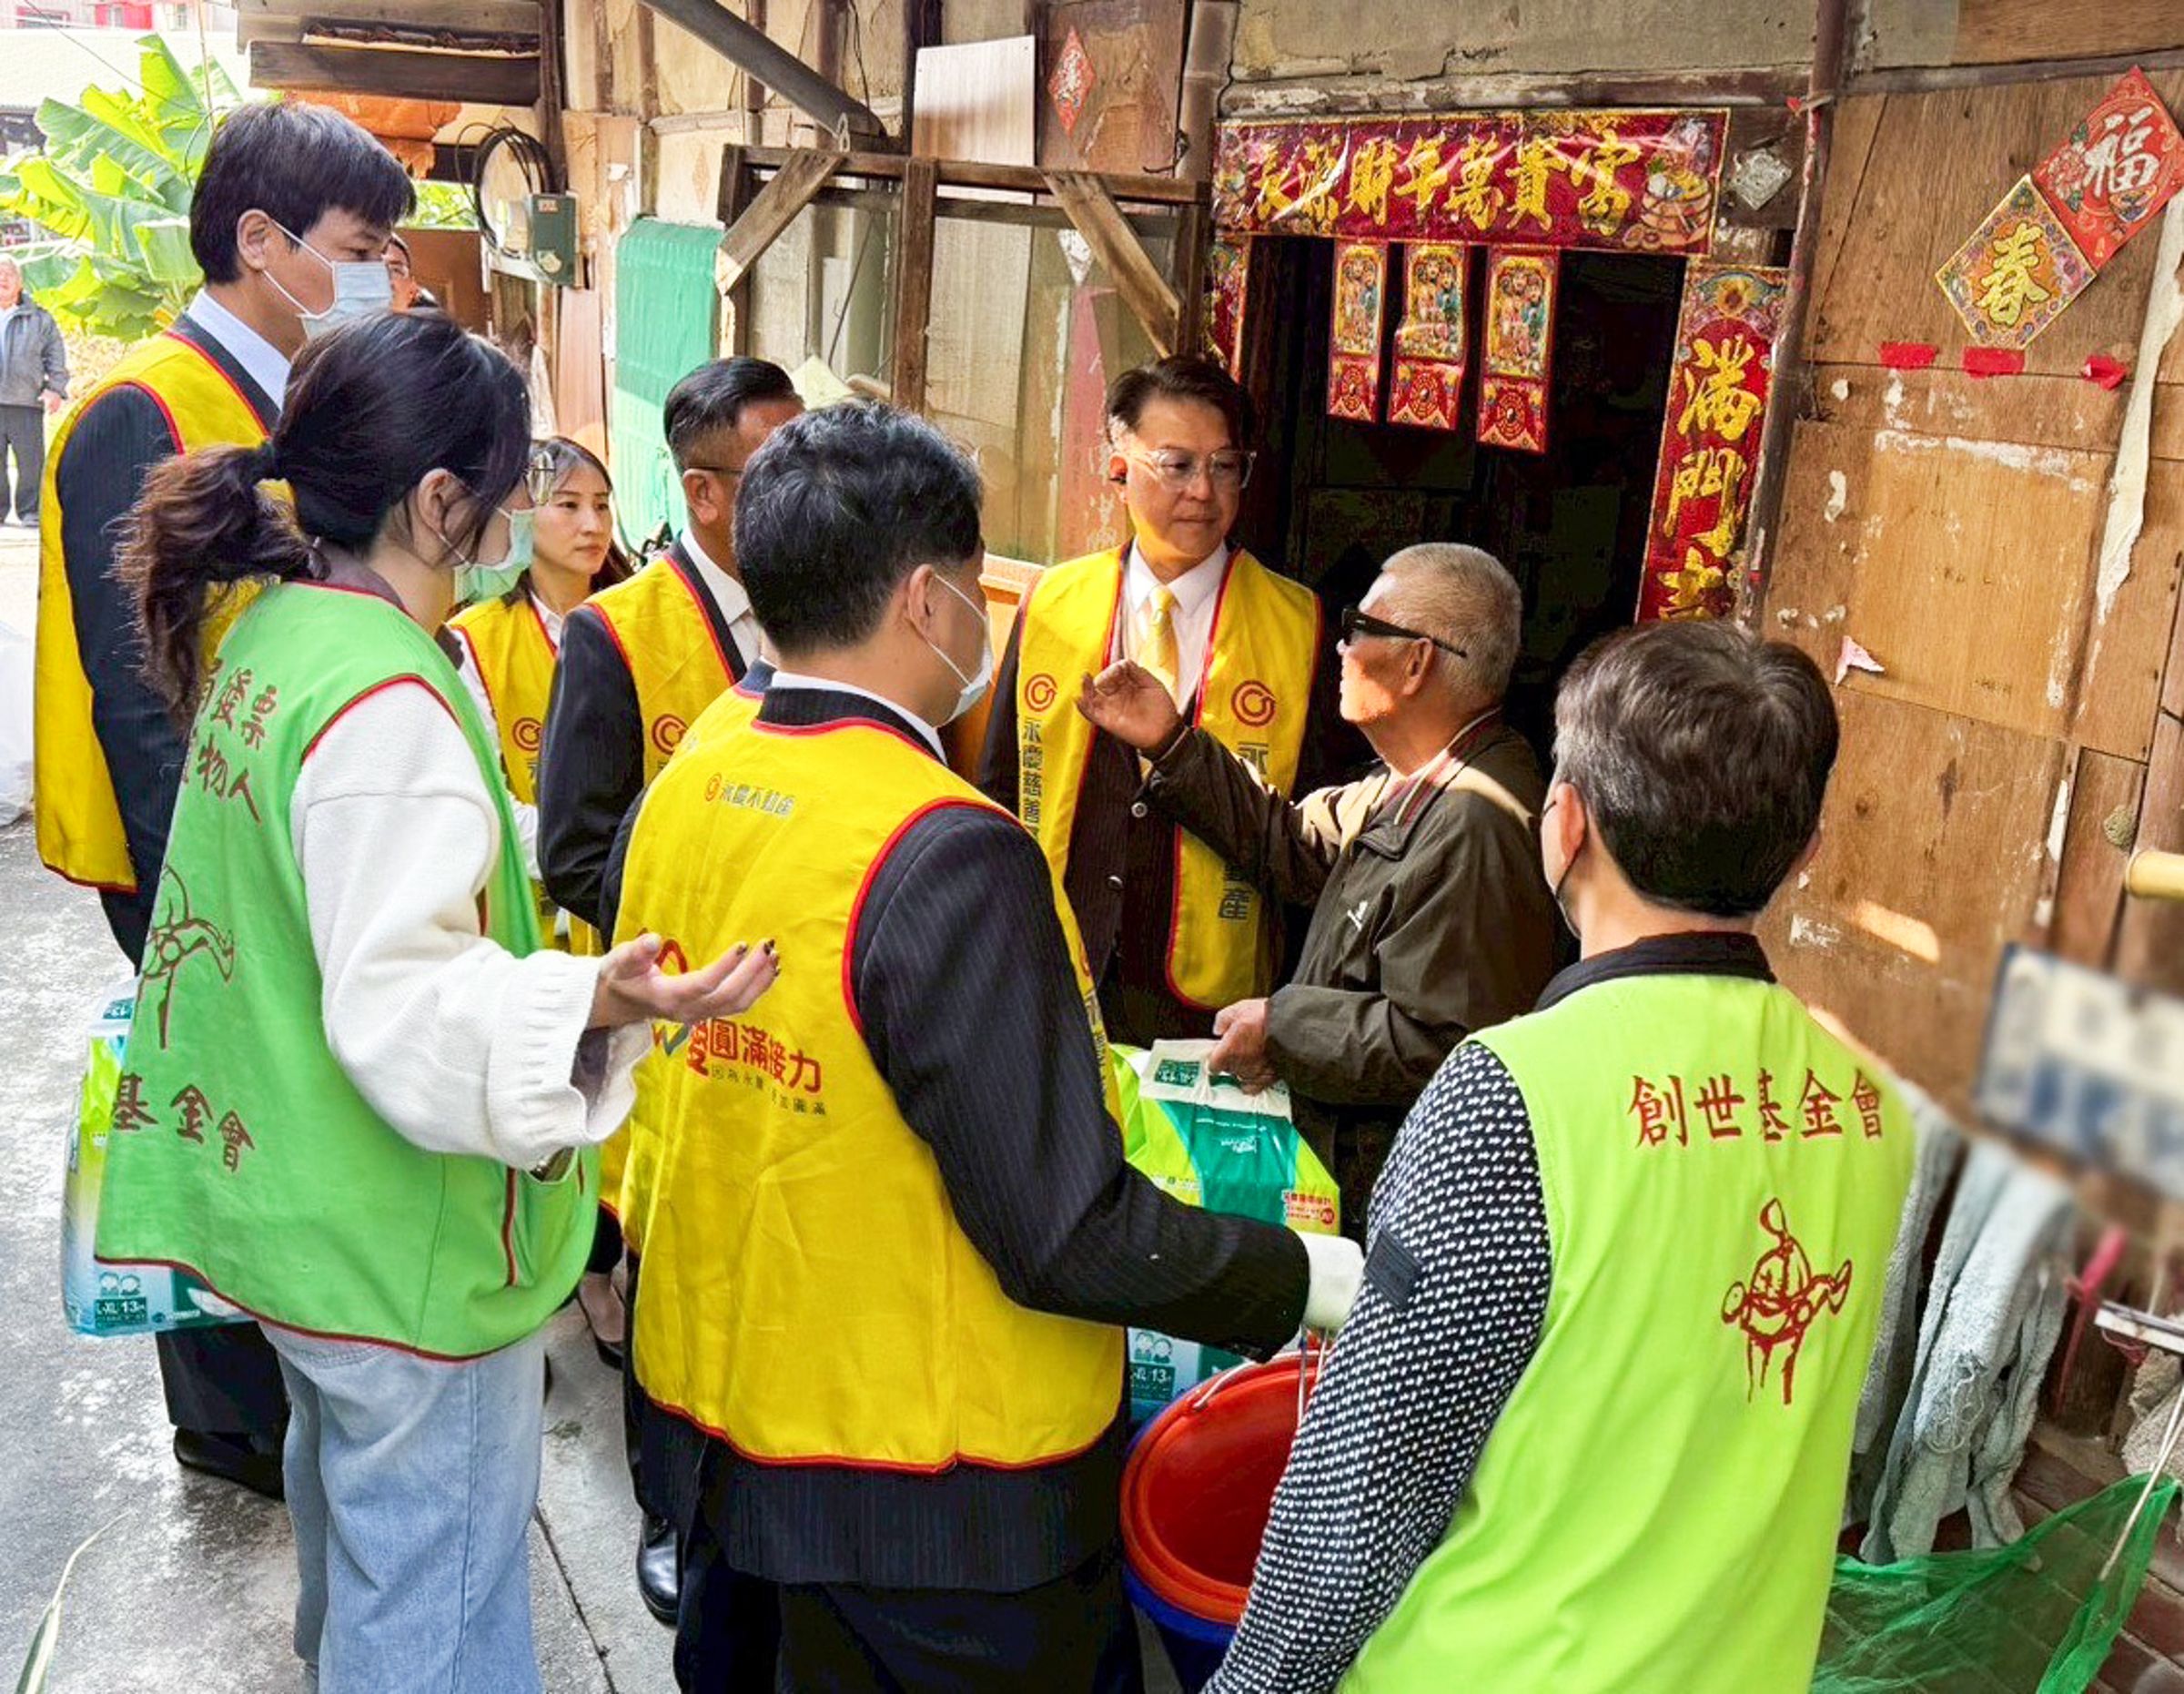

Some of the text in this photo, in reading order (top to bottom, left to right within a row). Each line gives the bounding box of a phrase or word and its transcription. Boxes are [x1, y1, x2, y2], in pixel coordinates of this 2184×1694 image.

[2082, 105, 2160, 199] 福
[1975, 221, 2051, 327] 春
[183, 726, 262, 824] 物人
[111, 1071, 256, 1172] 基金會
[1627, 1067, 1884, 1149] 創世基金會
